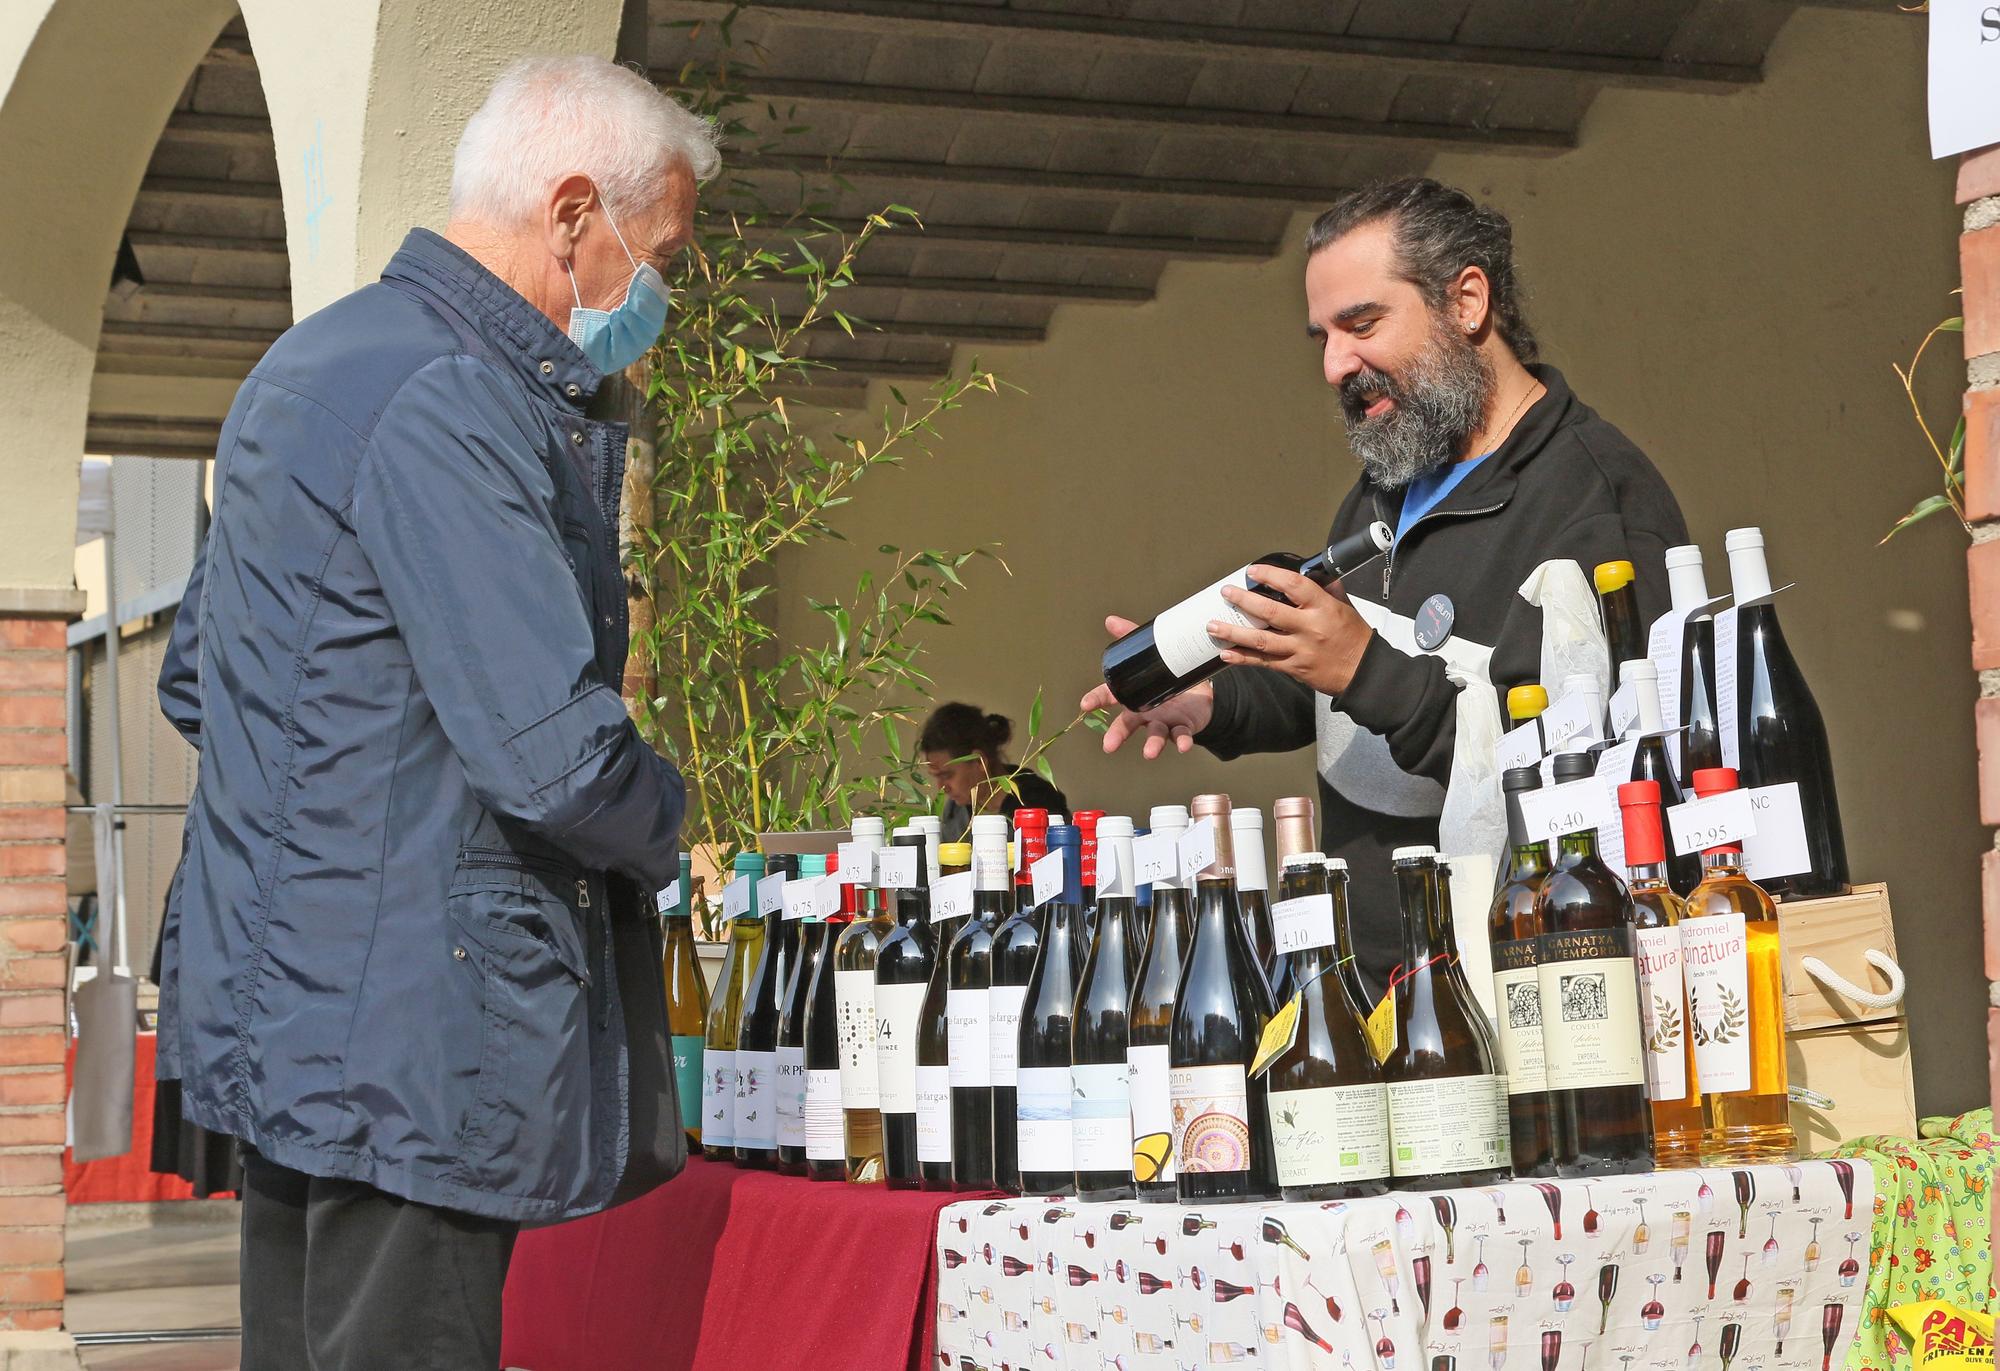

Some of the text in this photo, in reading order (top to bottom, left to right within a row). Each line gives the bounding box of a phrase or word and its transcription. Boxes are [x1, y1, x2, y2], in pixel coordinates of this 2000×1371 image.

[1551, 720, 1575, 744] 10.20
[1751, 795, 1770, 810] NC
[1548, 811, 1584, 833] 6.40
[1685, 825, 1728, 849] 12.95
[1144, 862, 1162, 878] 7.75
[1187, 852, 1203, 872] 8.95
[845, 866, 860, 880] 9.75
[884, 871, 904, 884] 14.50
[792, 901, 812, 914] 9.75
[819, 899, 833, 916] 10.10
[933, 899, 956, 919] 14.50
[1682, 922, 1730, 938] hidromiel
[1282, 929, 1308, 948] 4.10
[1968, 1347, 1985, 1356] EN
